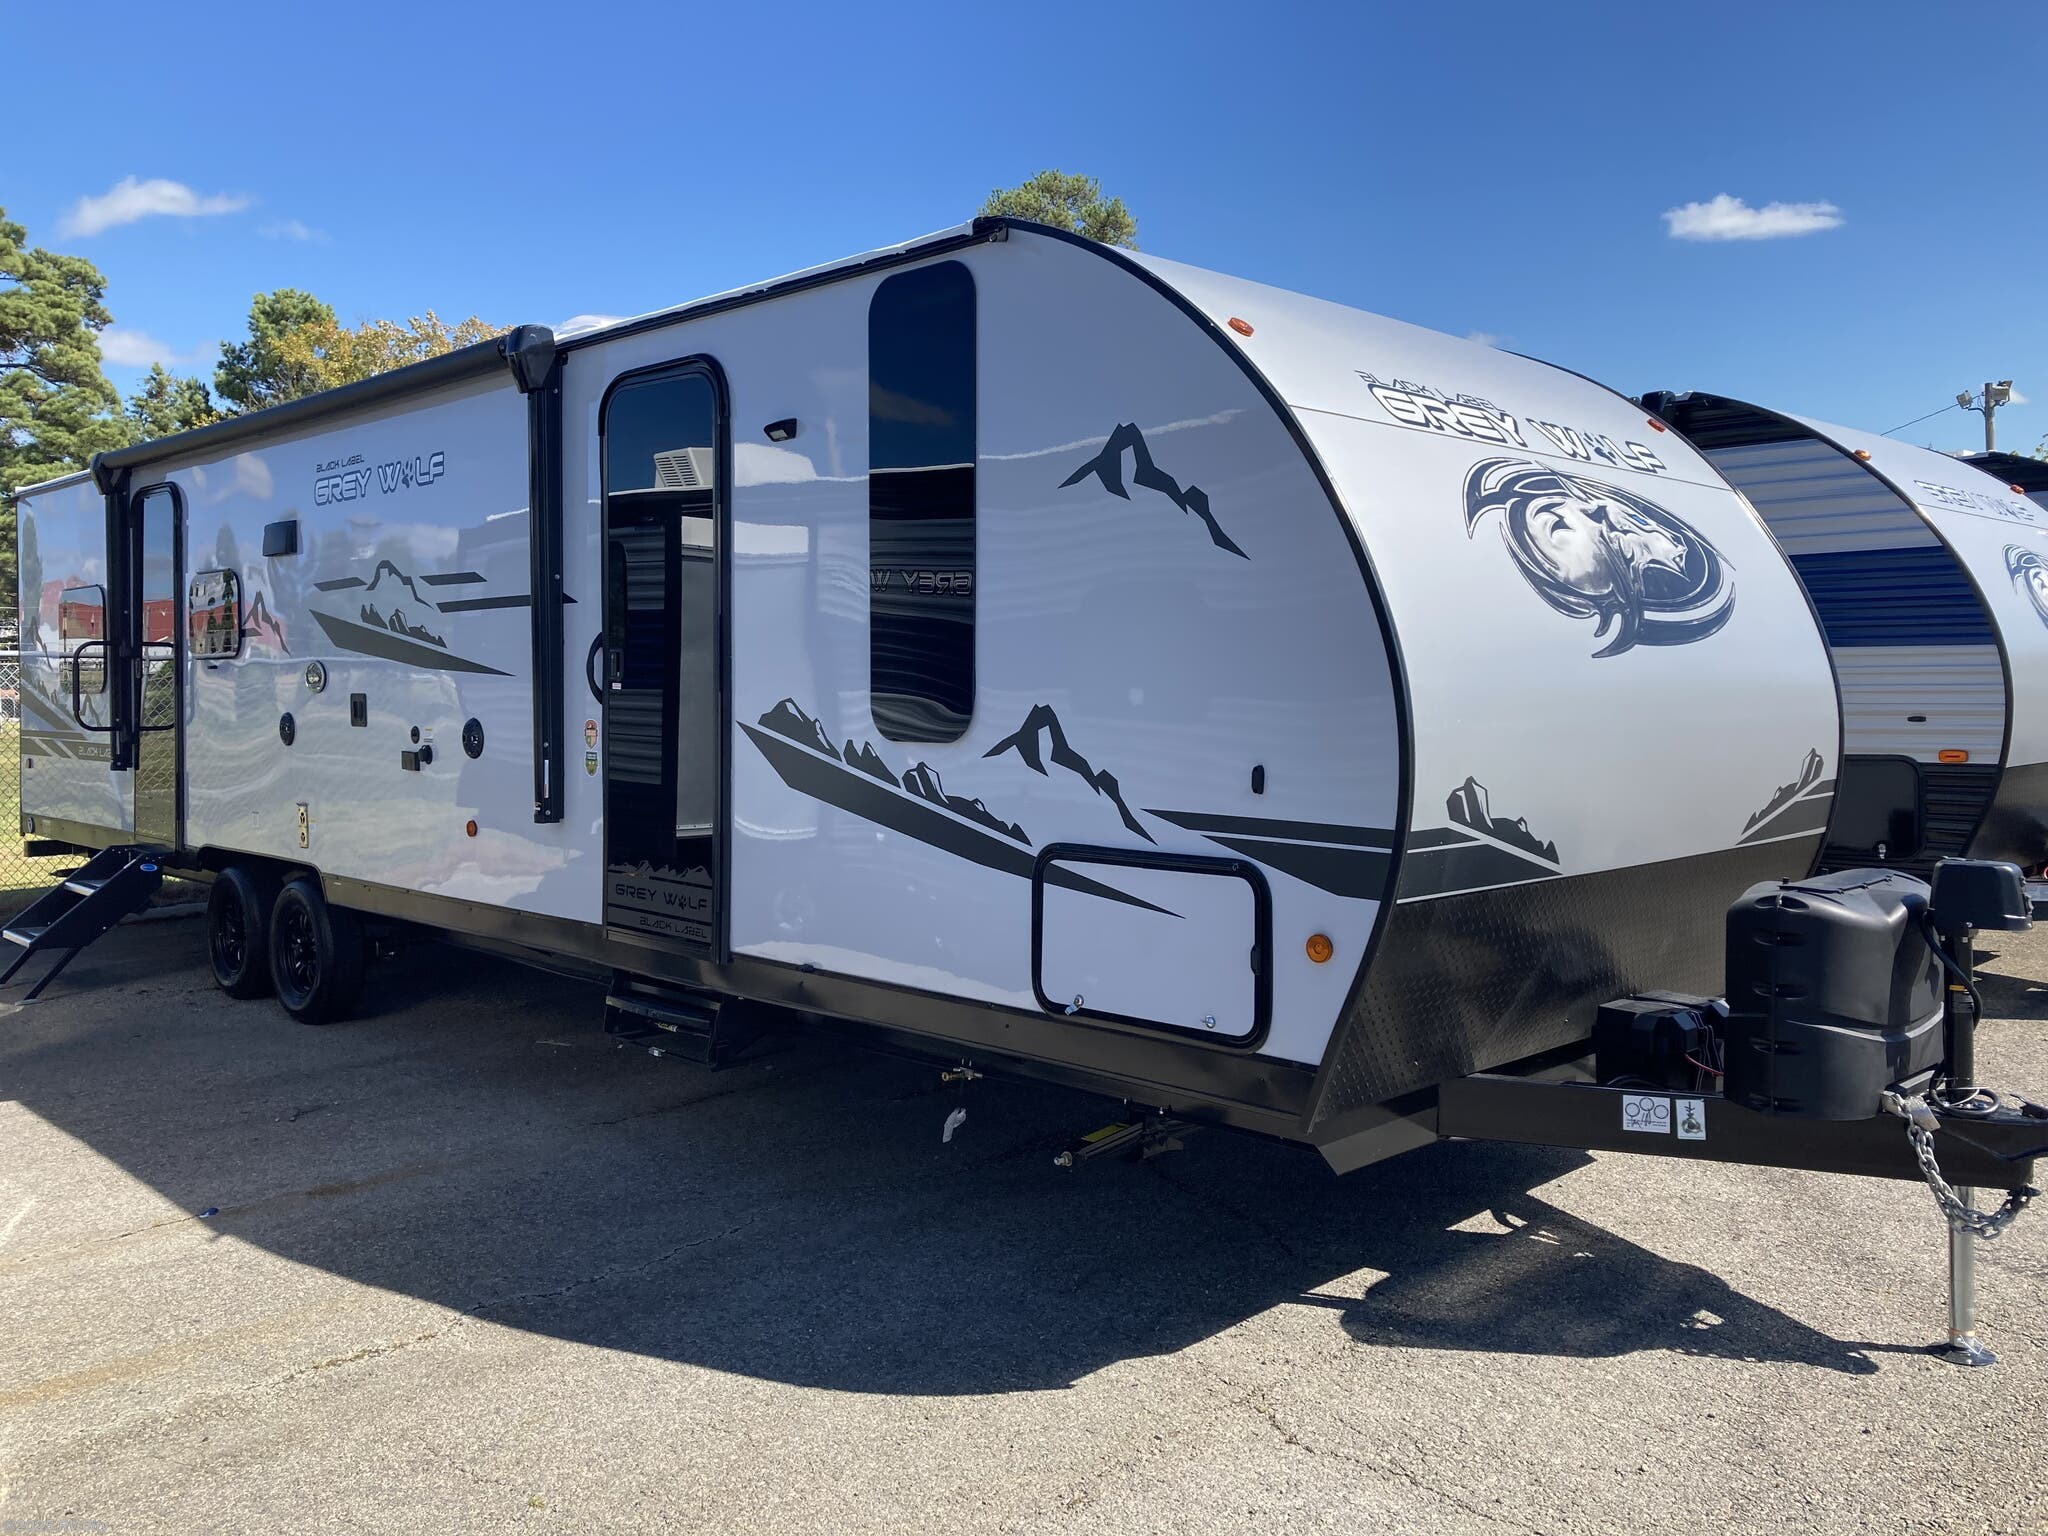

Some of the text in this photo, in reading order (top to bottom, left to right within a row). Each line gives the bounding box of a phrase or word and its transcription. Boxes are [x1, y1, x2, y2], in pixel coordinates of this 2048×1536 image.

[1354, 369, 1506, 413] BLACK LABEL
[1367, 382, 1529, 449] GREY
[316, 454, 365, 473] BLACK LABEL
[314, 467, 372, 506] GREY
[615, 883, 657, 902] GREY
[639, 916, 708, 939] BLACK LABEL
